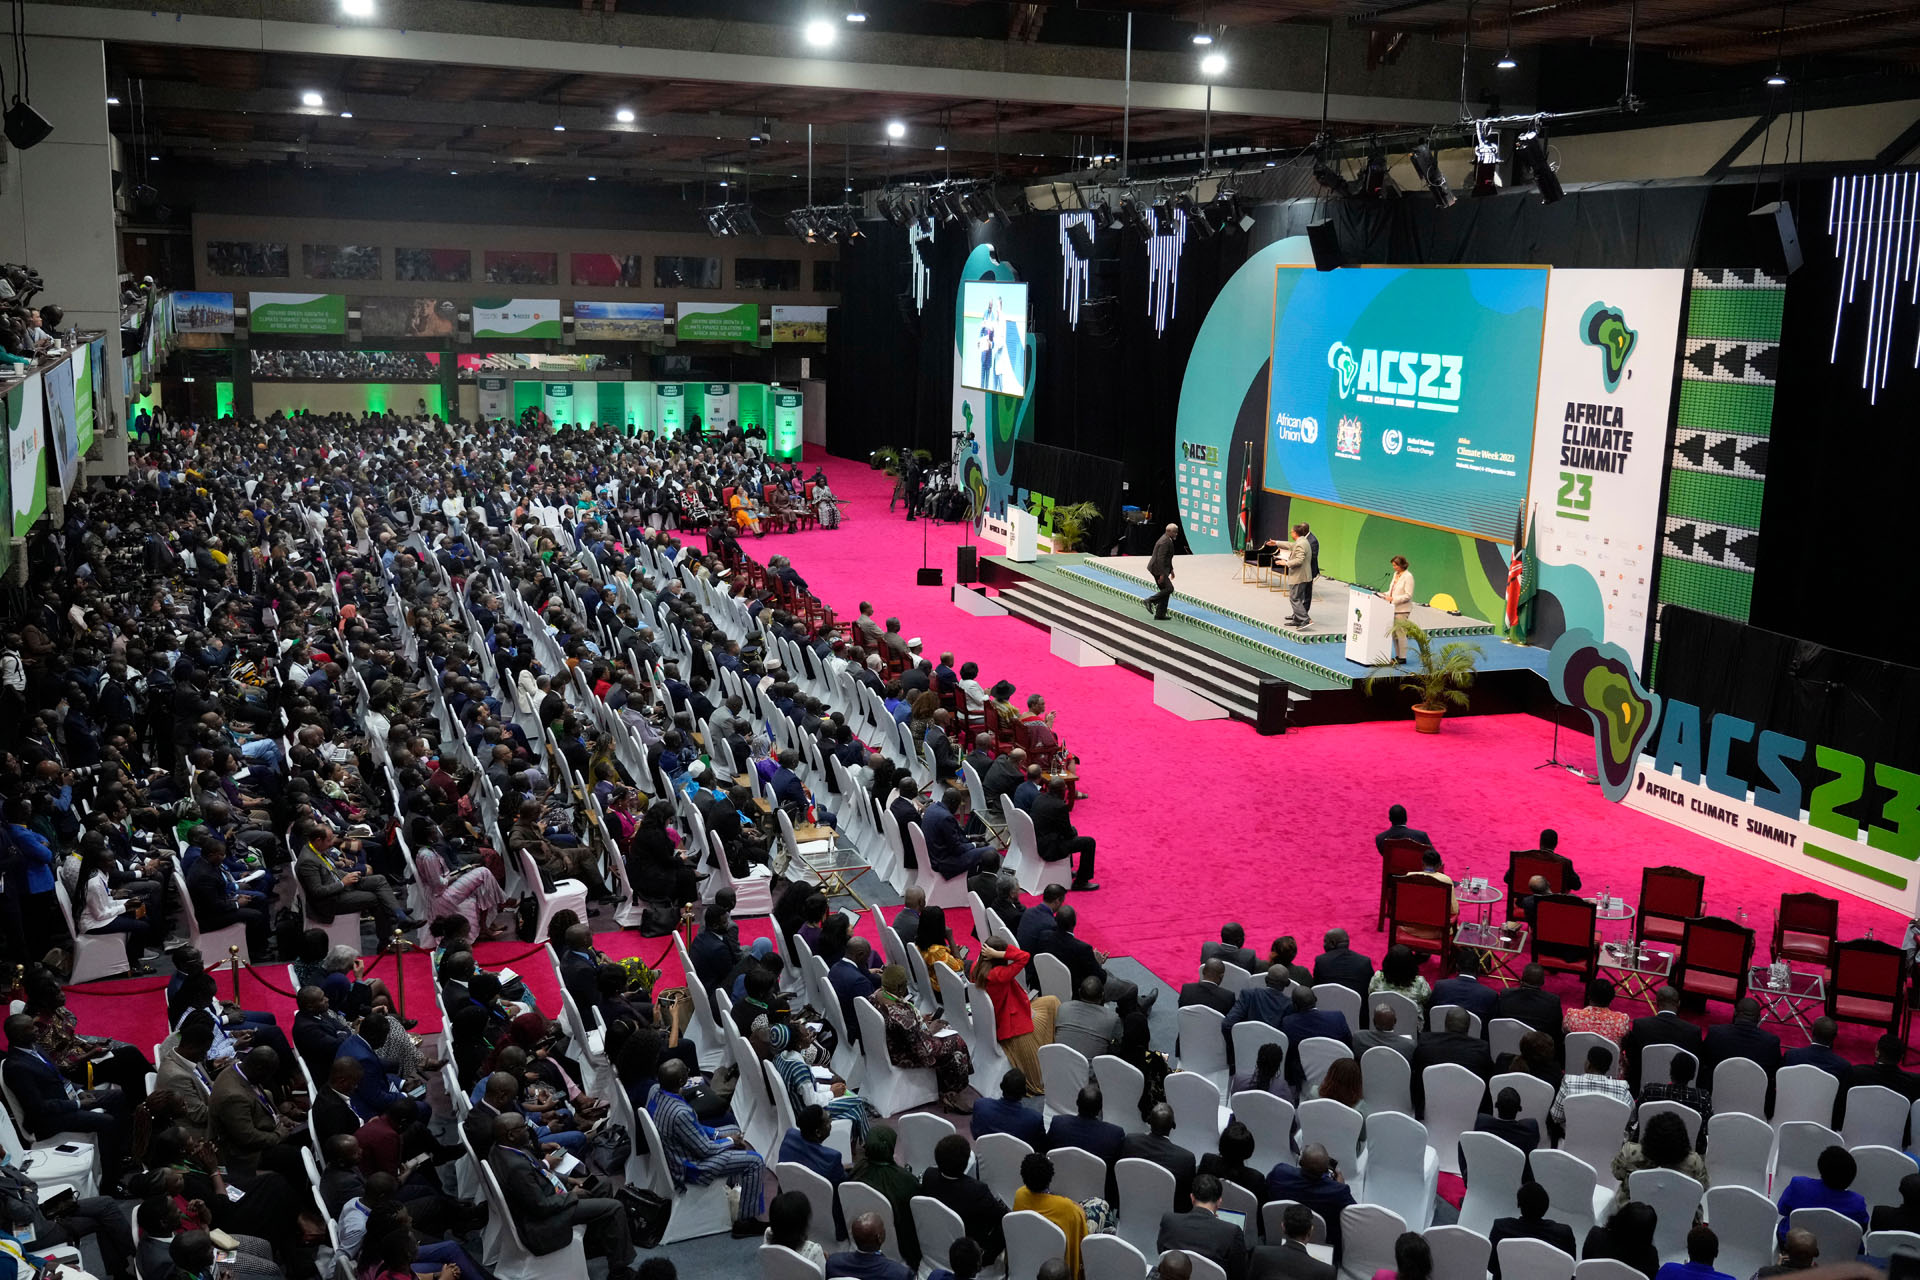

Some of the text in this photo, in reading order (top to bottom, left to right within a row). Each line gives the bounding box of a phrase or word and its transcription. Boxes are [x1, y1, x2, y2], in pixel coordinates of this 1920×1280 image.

[1357, 348, 1464, 401] ACS23
[1275, 412, 1302, 429] African
[1564, 402, 1624, 428] AFRICA
[1279, 426, 1301, 442] Union
[1562, 424, 1634, 453] CLIMATE
[1457, 447, 1481, 459] Climate
[1481, 450, 1499, 461] Week
[1559, 445, 1628, 475] SUMMIT
[1557, 471, 1593, 511] 23
[1654, 698, 1920, 861] ACS23
[1646, 782, 1798, 848] AFRICA CLIMATE SUMMIT
